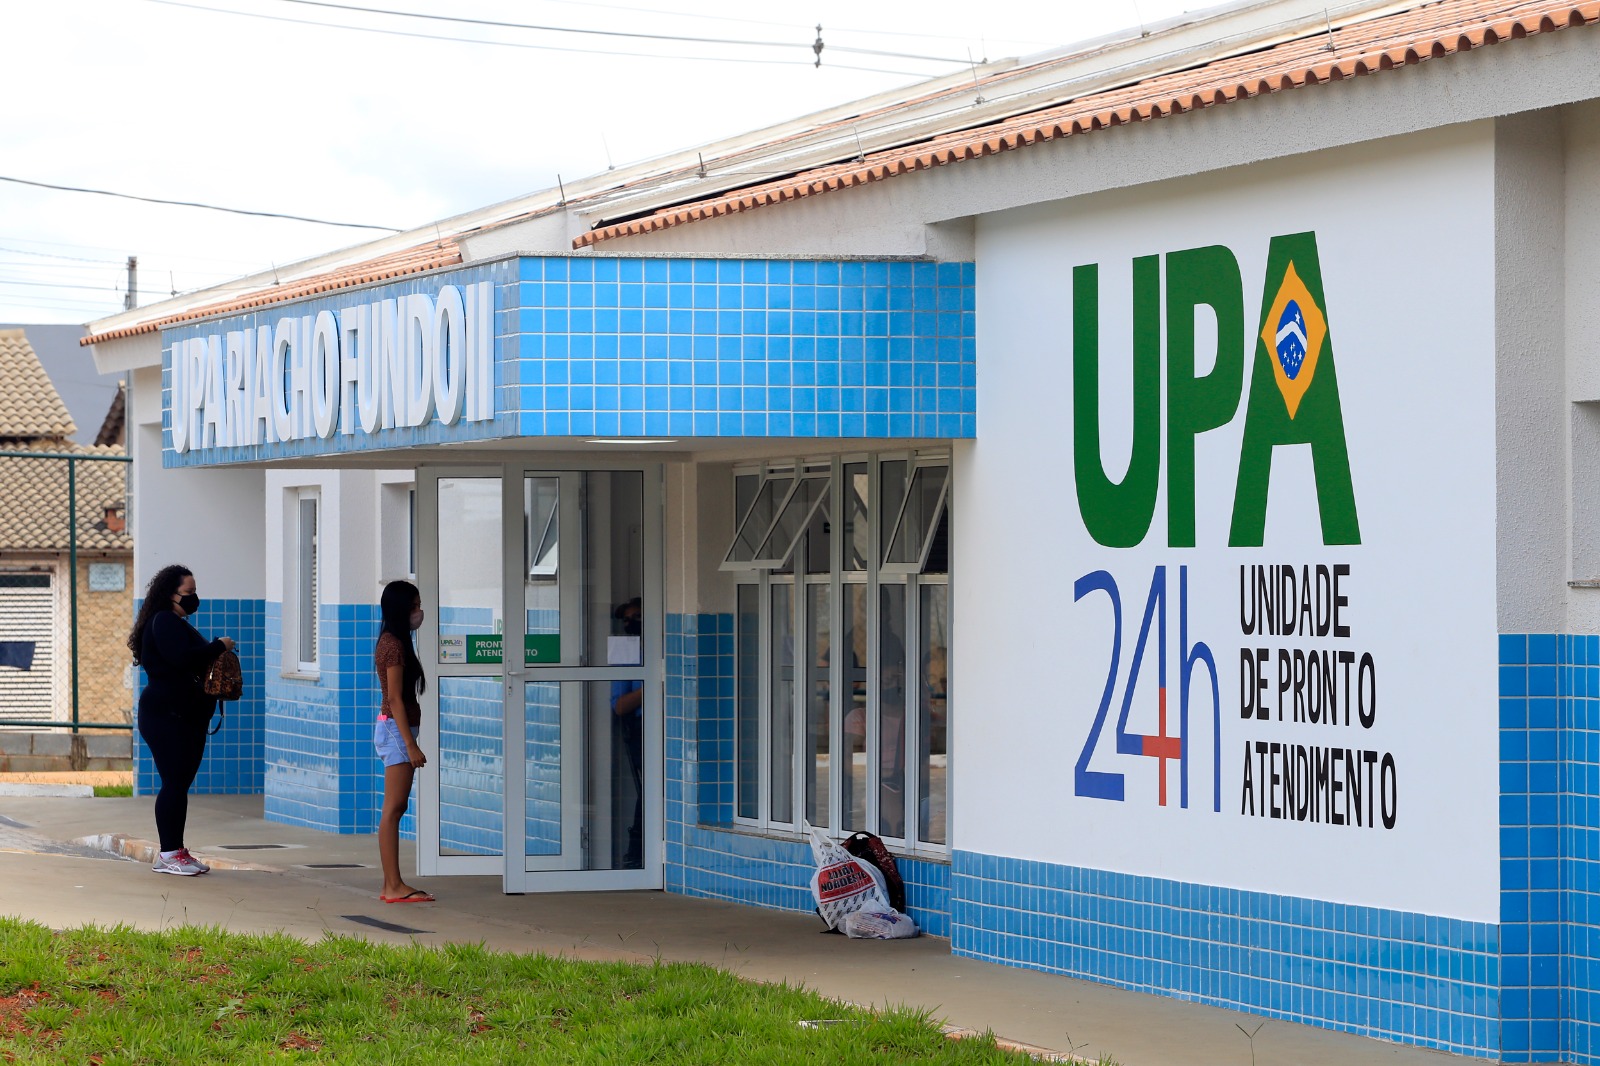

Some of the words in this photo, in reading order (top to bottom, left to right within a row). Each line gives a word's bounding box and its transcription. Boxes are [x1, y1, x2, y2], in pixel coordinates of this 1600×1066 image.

[171, 334, 227, 453] UPA
[226, 310, 340, 447] RIACHO
[340, 285, 466, 435] FUNDO
[1073, 231, 1362, 548] UPA
[475, 640, 503, 649] PRONT
[1240, 564, 1350, 638] UNIDADE
[1074, 565, 1221, 812] 24h
[1240, 647, 1270, 720] DE
[1278, 648, 1376, 729] PRONTO
[1241, 740, 1397, 830] ATENDIMENTO
